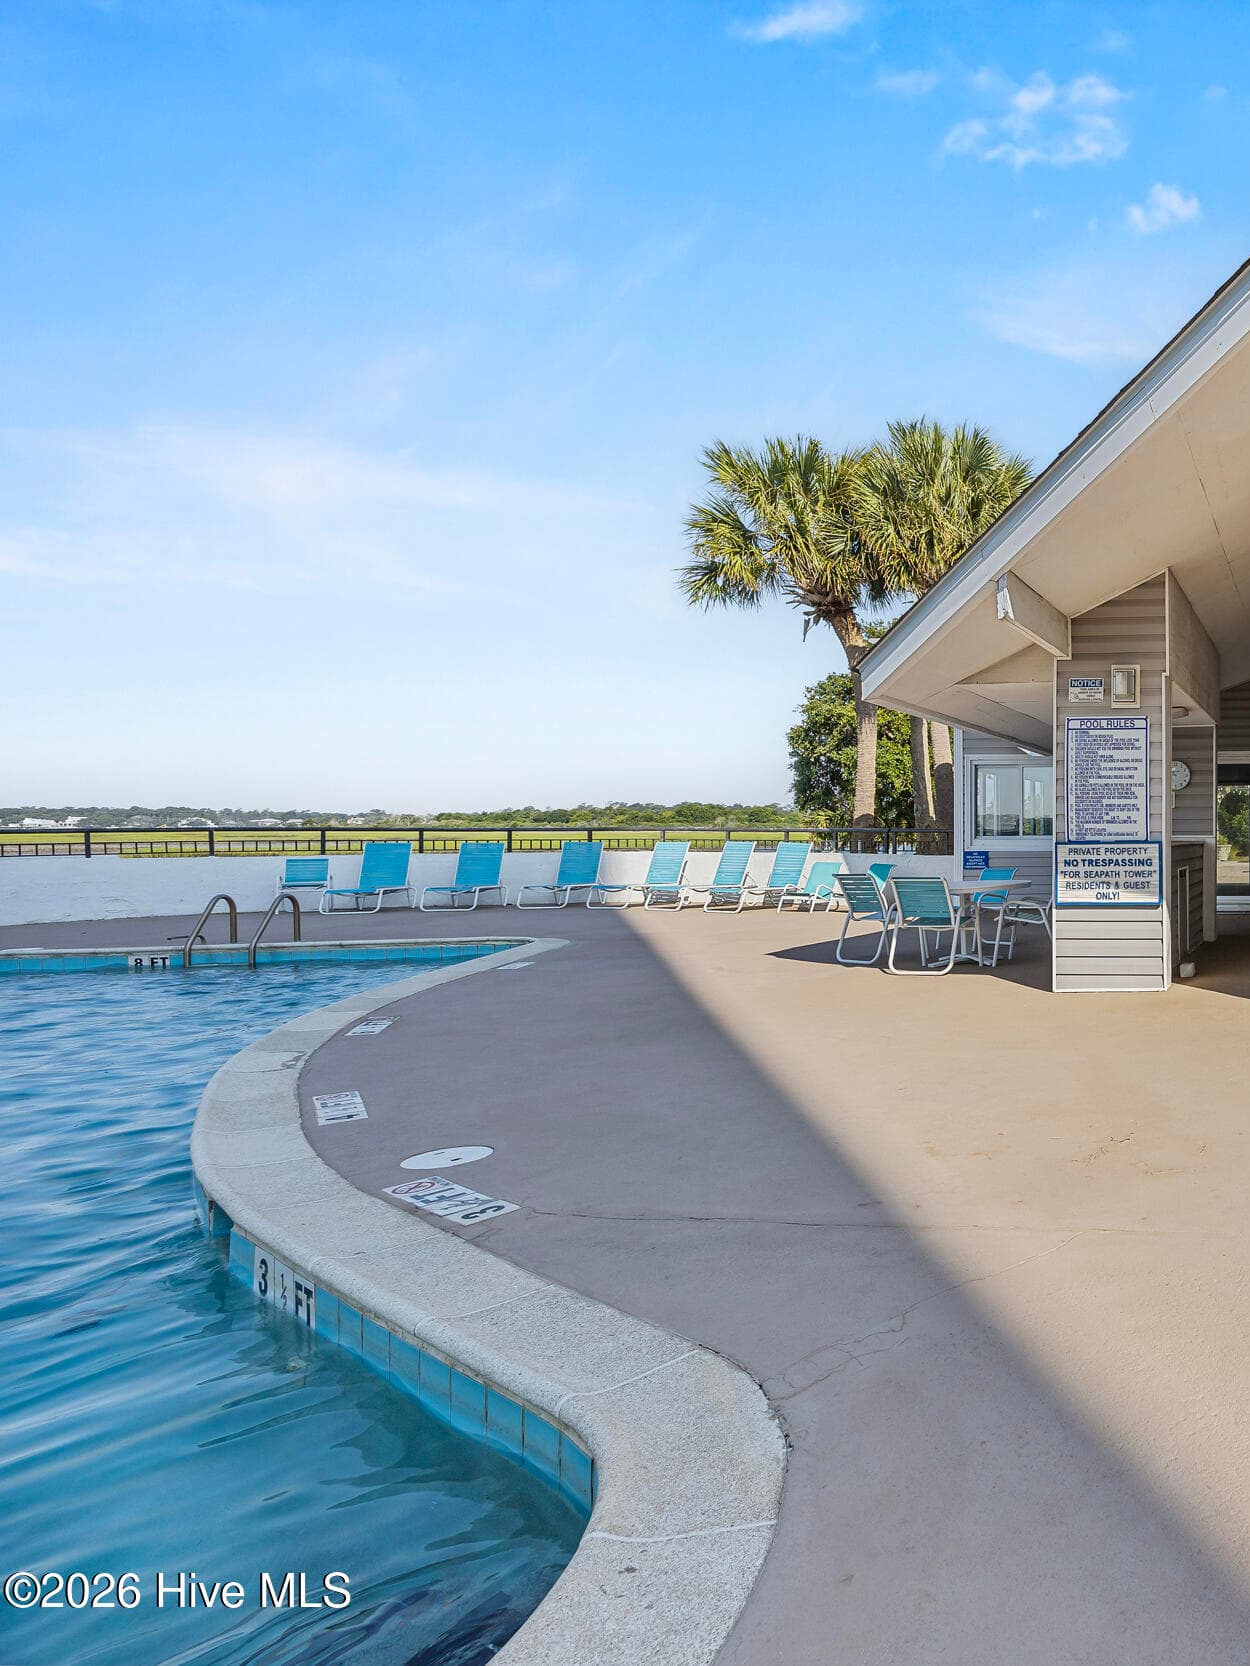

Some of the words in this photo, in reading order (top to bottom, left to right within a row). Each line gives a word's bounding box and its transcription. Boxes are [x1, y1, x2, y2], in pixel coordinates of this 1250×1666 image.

[1071, 679, 1102, 687] NOTICE
[1079, 720, 1104, 728] POOL
[1106, 720, 1136, 728] RULES
[1068, 847, 1101, 856] PRIVATE
[1104, 847, 1148, 855] PROPERTY
[1063, 859, 1079, 867] NO
[1081, 858, 1153, 867] TRESPASSING
[1060, 870, 1081, 879] "FOR
[1083, 870, 1120, 878] SEAPATH
[1124, 870, 1157, 878] TOWER"
[1065, 881, 1111, 890] RESIDENTS
[1114, 881, 1120, 889] &
[1123, 881, 1151, 889] GUEST
[1095, 892, 1120, 901] ONLY!
[134, 957, 143, 967] 8
[150, 956, 169, 969] FT
[410, 1187, 467, 1205] FT
[461, 1204, 505, 1220] 3
[258, 1257, 269, 1297] 3
[294, 1279, 314, 1329] FT
